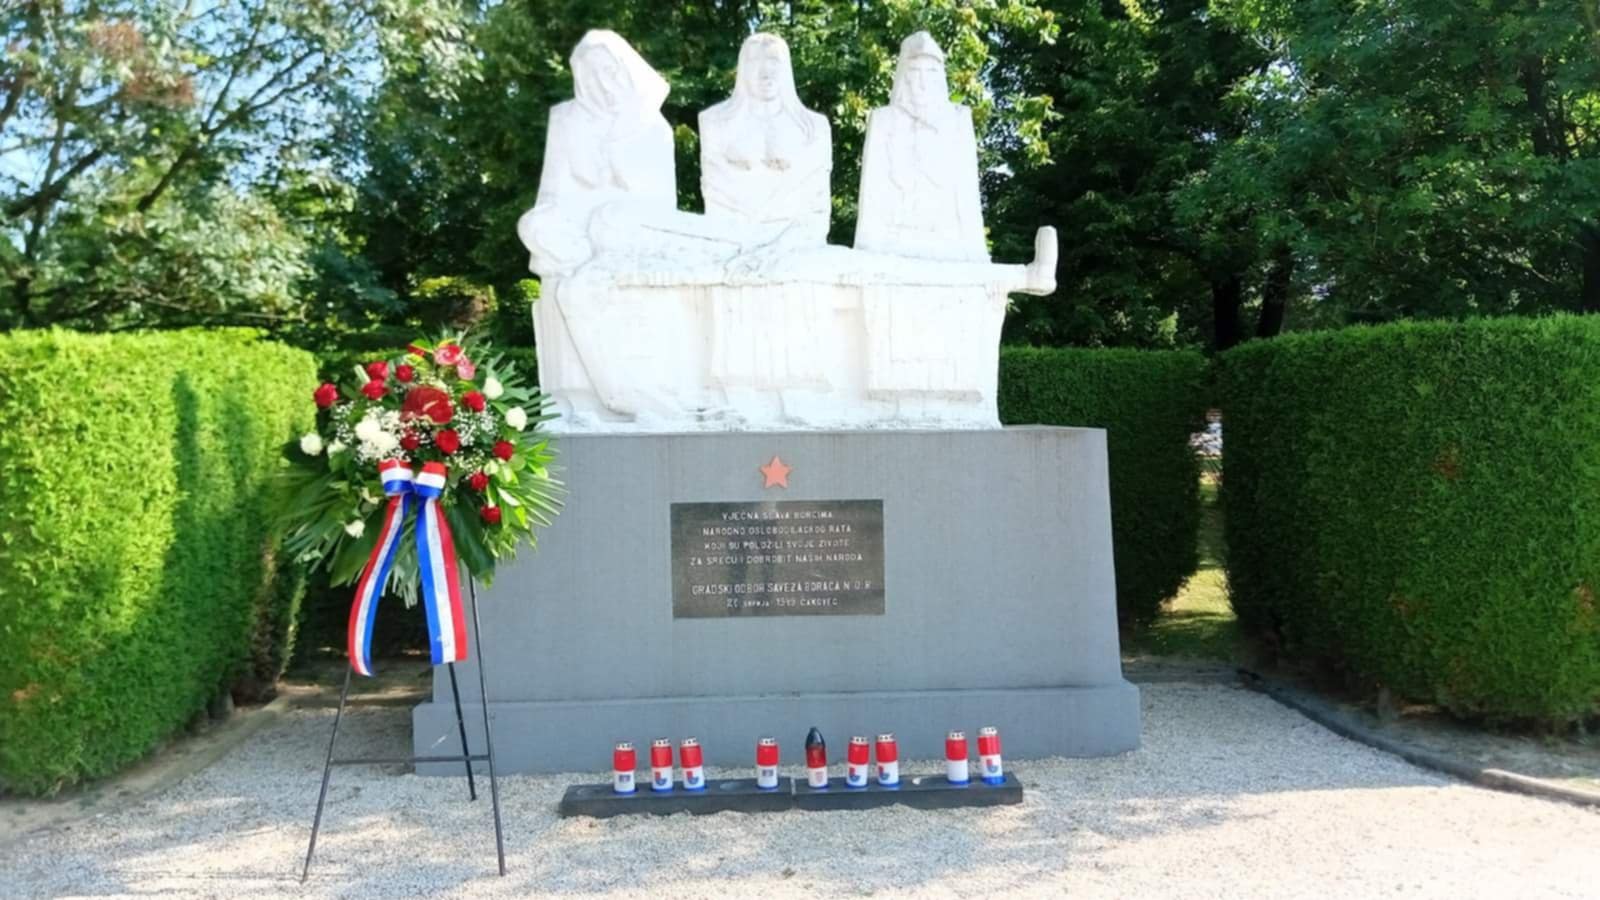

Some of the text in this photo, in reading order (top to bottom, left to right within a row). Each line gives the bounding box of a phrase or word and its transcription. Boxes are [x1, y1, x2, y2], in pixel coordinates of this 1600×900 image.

[702, 527, 745, 536] NARODNO
[829, 524, 852, 533] RATA
[690, 556, 703, 566] ZA
[826, 552, 863, 562] NARODA
[767, 581, 802, 592] SAVEZA
[804, 581, 841, 592] BORACA
